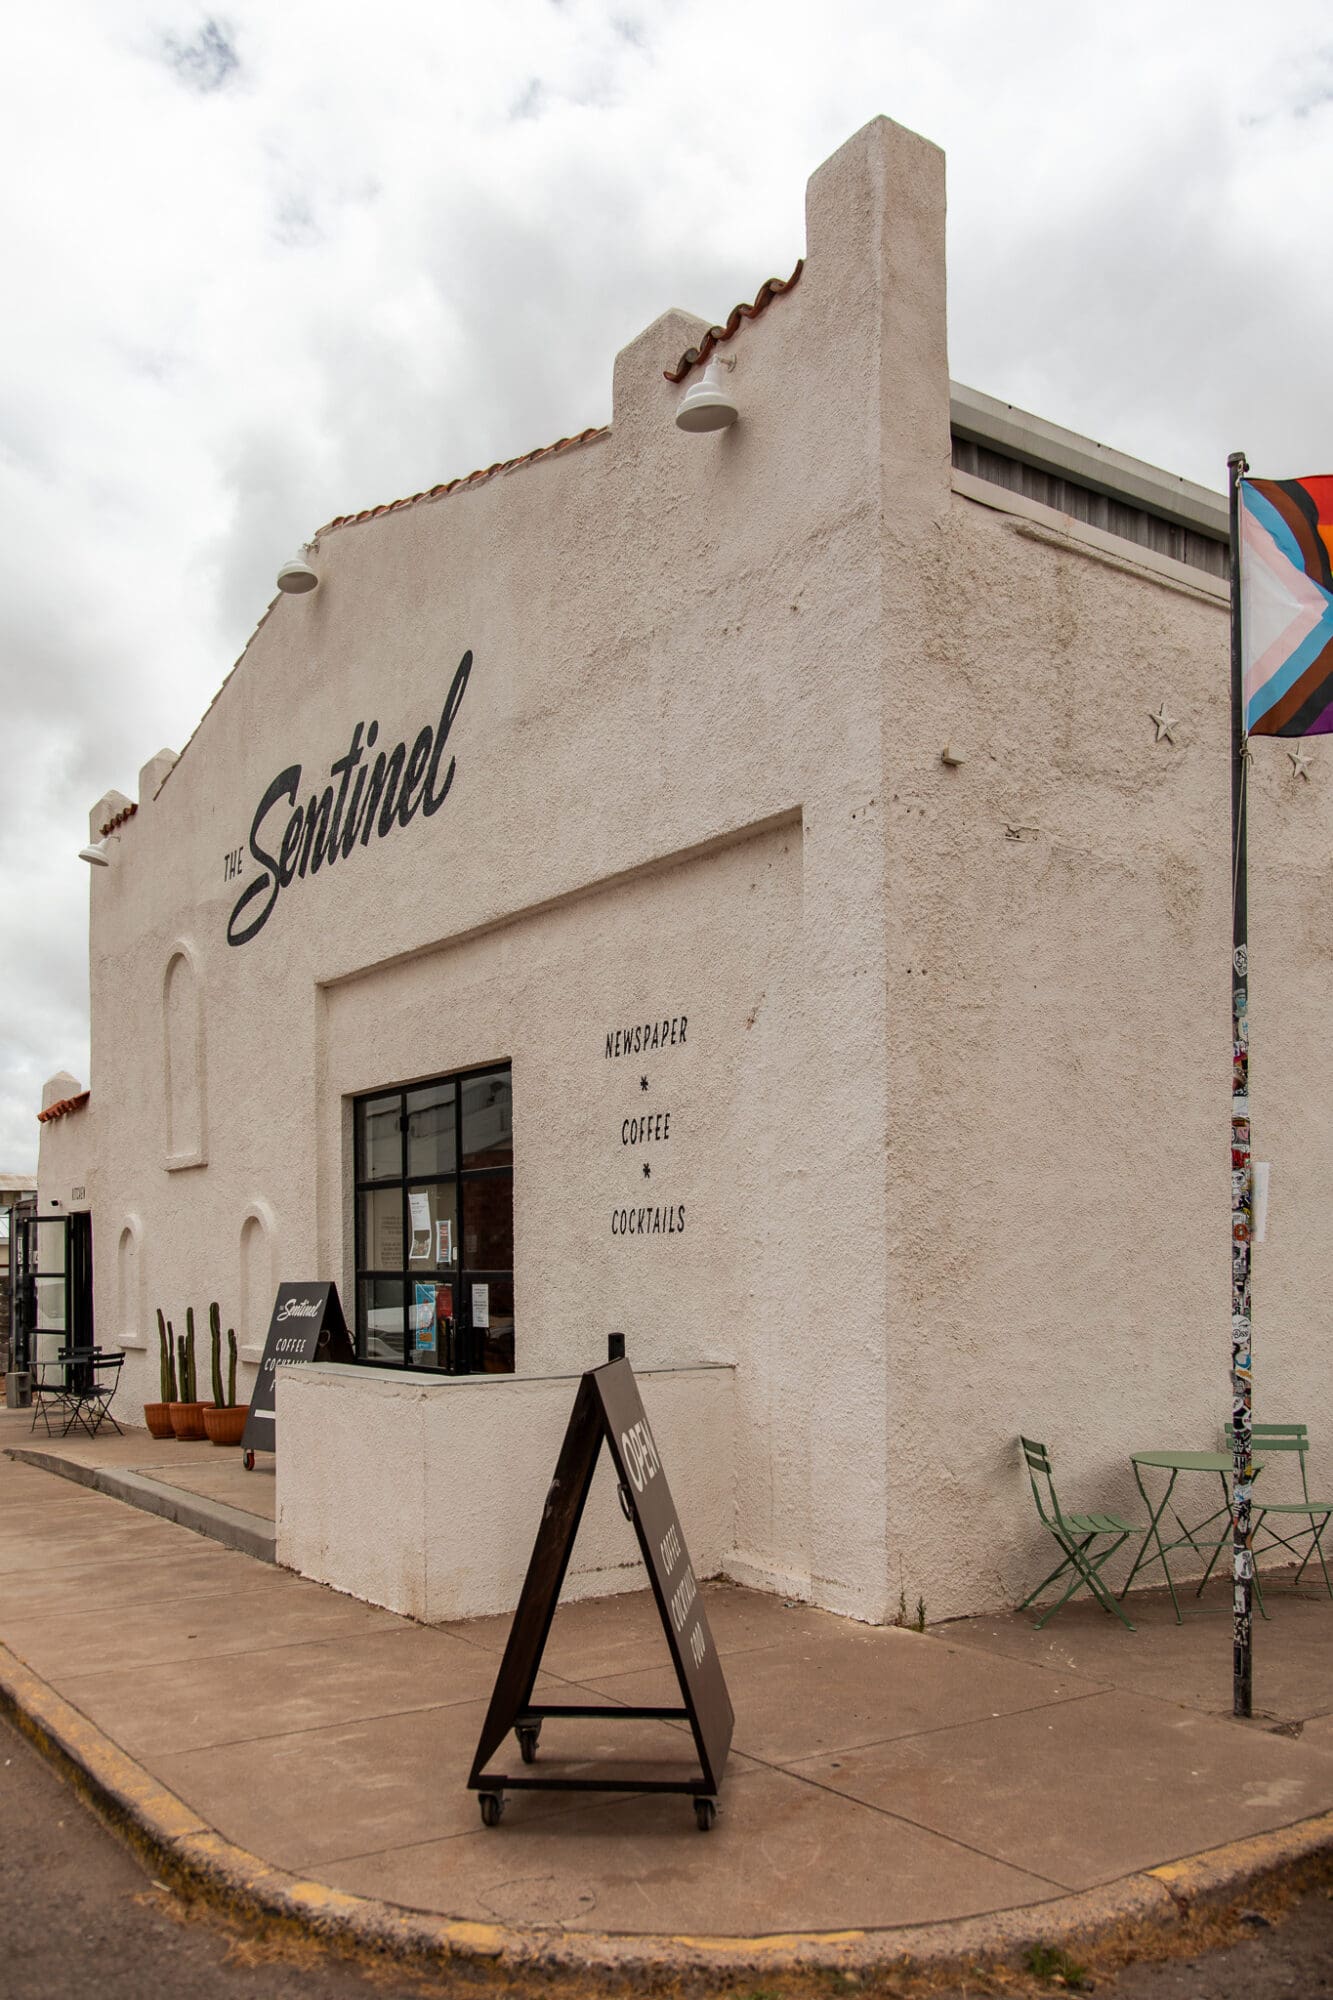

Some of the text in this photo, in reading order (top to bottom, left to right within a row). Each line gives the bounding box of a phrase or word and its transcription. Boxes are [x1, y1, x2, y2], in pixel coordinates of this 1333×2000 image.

[223, 650, 473, 946] THE Sentinel
[605, 1016, 688, 1059] NEWSPAPER
[621, 1113, 671, 1145] COFFEE
[611, 1205, 685, 1235] COCKTAILS
[276, 1298, 323, 1321] Sentinel
[276, 1338, 306, 1352] COFFEE
[621, 1417, 659, 1492] OPEN
